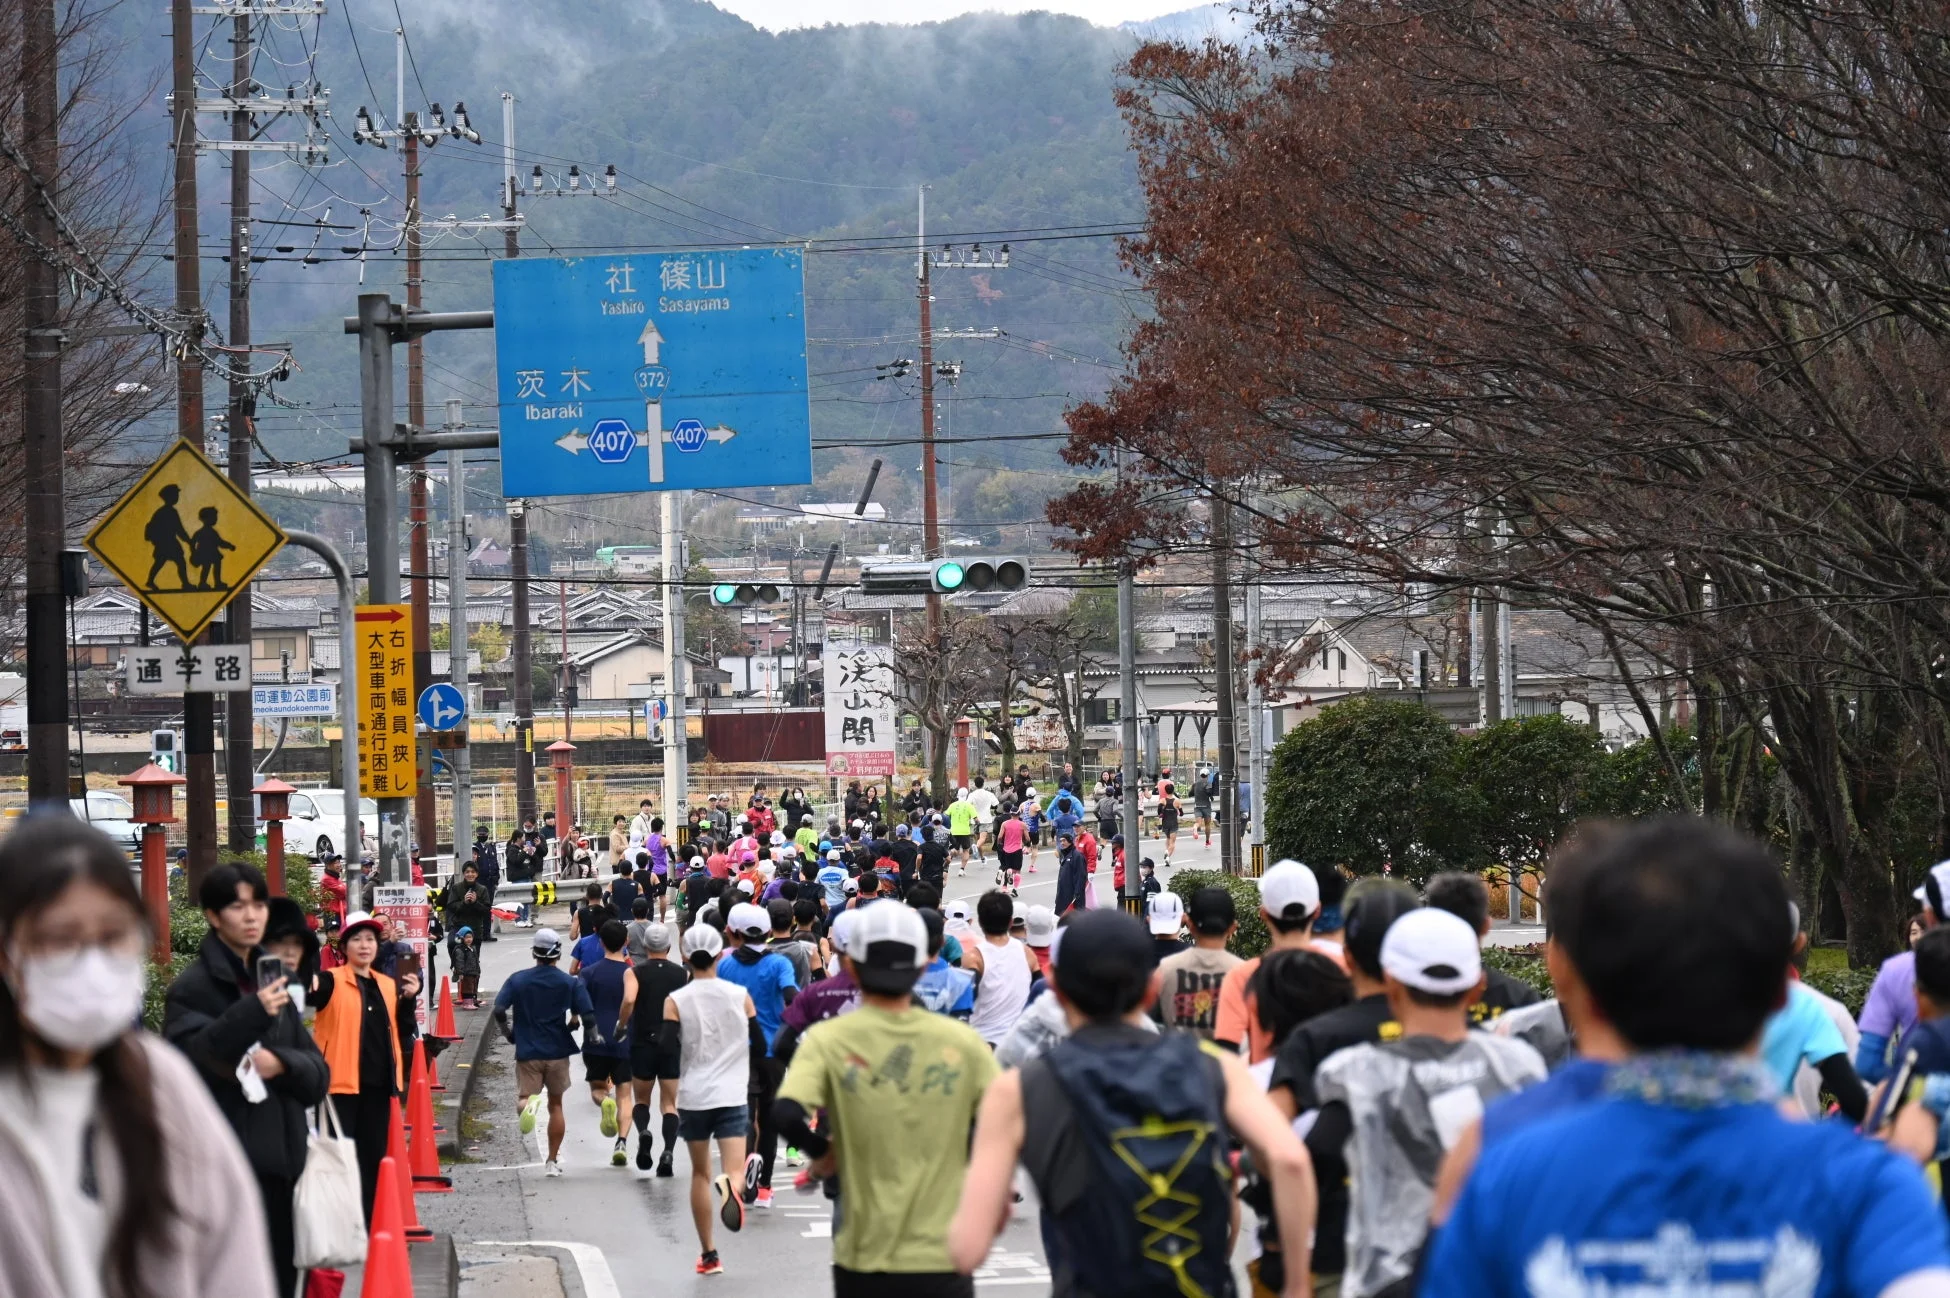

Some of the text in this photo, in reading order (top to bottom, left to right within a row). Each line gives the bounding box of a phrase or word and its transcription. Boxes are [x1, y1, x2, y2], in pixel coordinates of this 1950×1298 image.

[605, 259, 726, 294] 社 篠山
[600, 297, 730, 315] Yashiro Sasayama
[516, 365, 592, 399] 茨木
[639, 372, 664, 388] 372
[525, 402, 583, 420] Ibaraki
[594, 430, 628, 452] 407
[676, 428, 701, 444] 407
[136, 655, 241, 684] 通学路
[368, 631, 389, 793] 大型車両通行困難
[389, 630, 409, 791] 右折幅員狭し
[377, 897, 425, 905] ハーフマラソン
